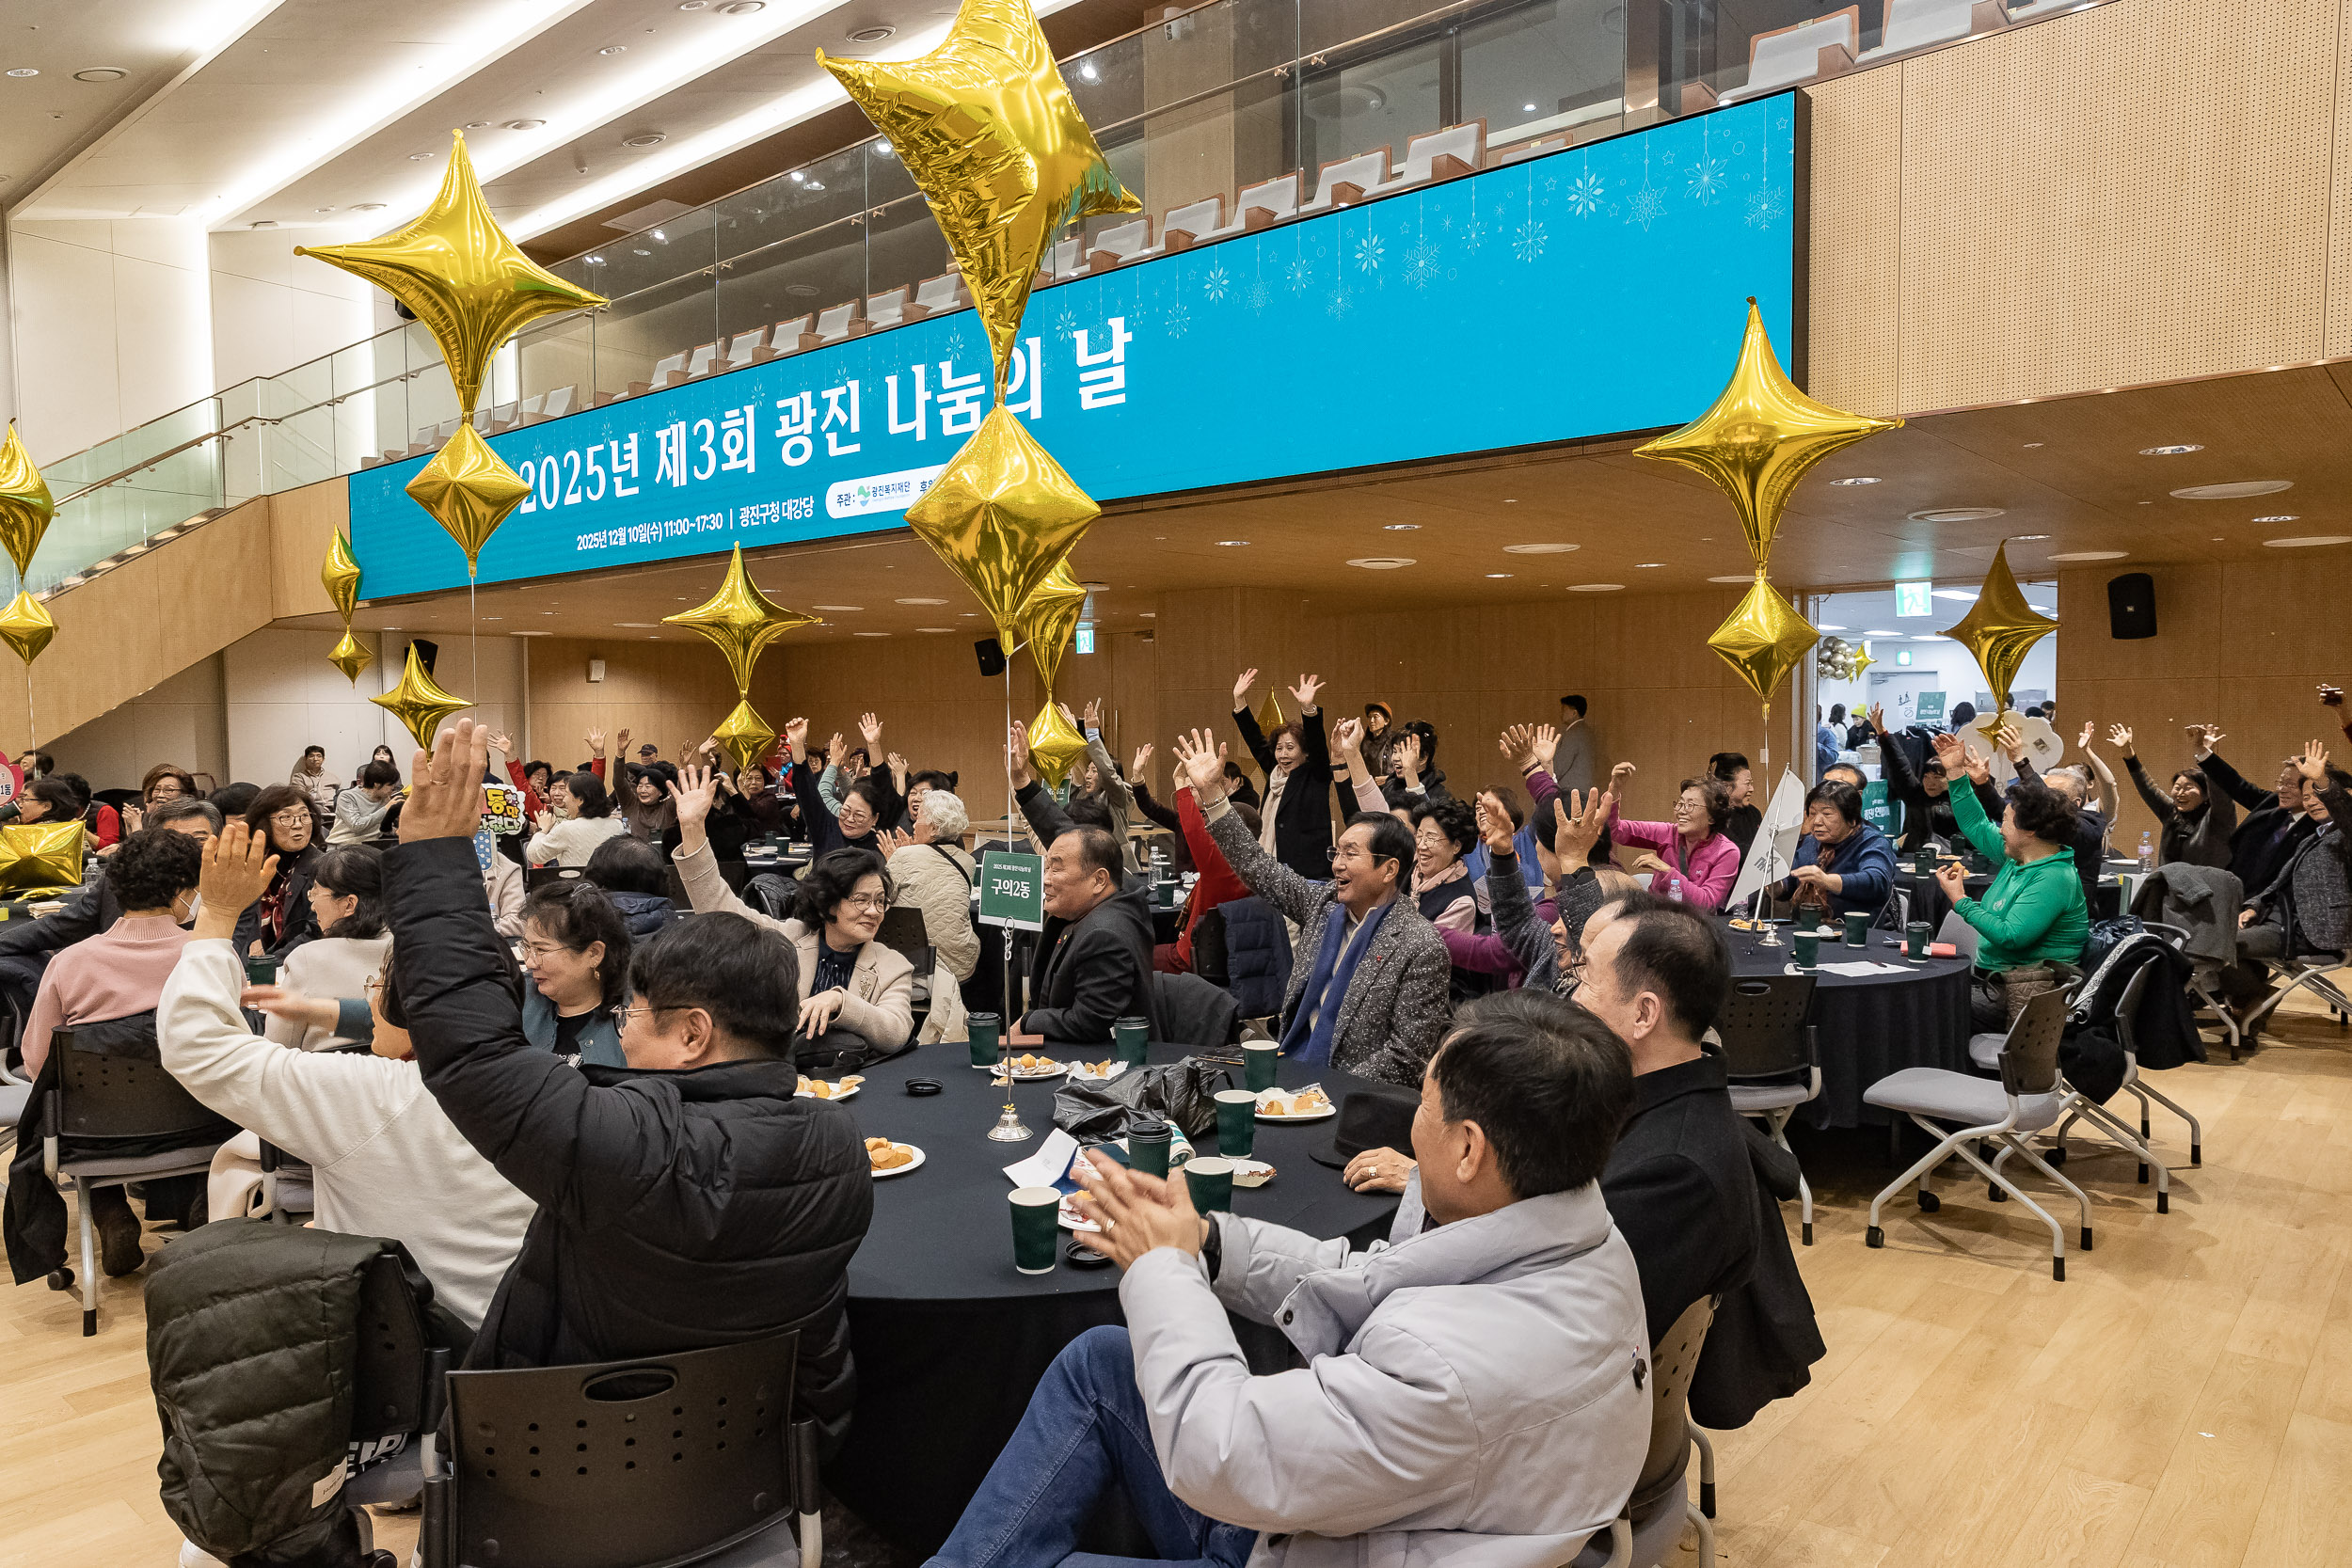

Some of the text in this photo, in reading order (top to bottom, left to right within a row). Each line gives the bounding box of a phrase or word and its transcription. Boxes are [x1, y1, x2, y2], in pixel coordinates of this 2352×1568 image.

[519, 316, 1132, 515] 2025년 제3회 광진 나눔의 날
[871, 481, 911, 498] 광진복지재단
[577, 495, 815, 551] 2025년 12월 10일(수) 11:00~17:30 광진구청 대강당
[991, 878, 1031, 899] 구의2동
